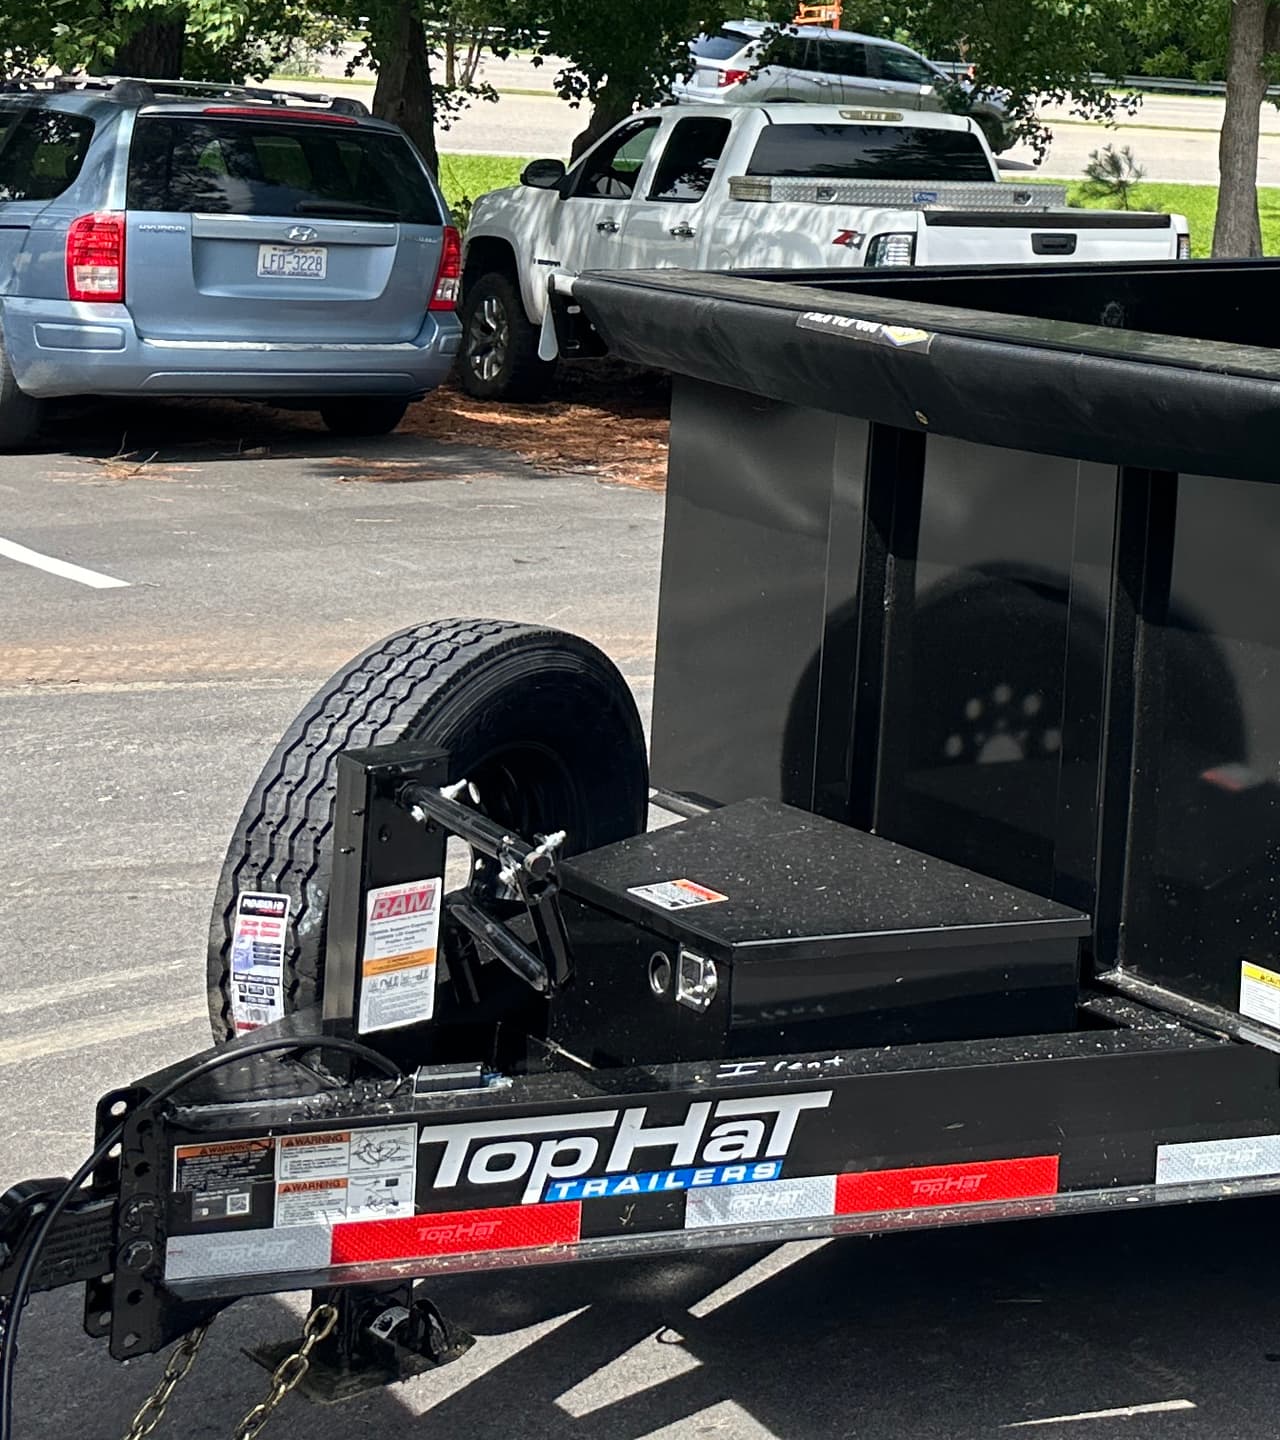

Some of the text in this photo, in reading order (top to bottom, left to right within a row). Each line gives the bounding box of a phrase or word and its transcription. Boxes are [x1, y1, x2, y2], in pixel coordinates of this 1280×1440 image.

[372, 889, 433, 919] RAM
[294, 1132, 343, 1146] WARNING
[292, 1180, 341, 1192] WARNING
[556, 1162, 780, 1200] TRAILERS
